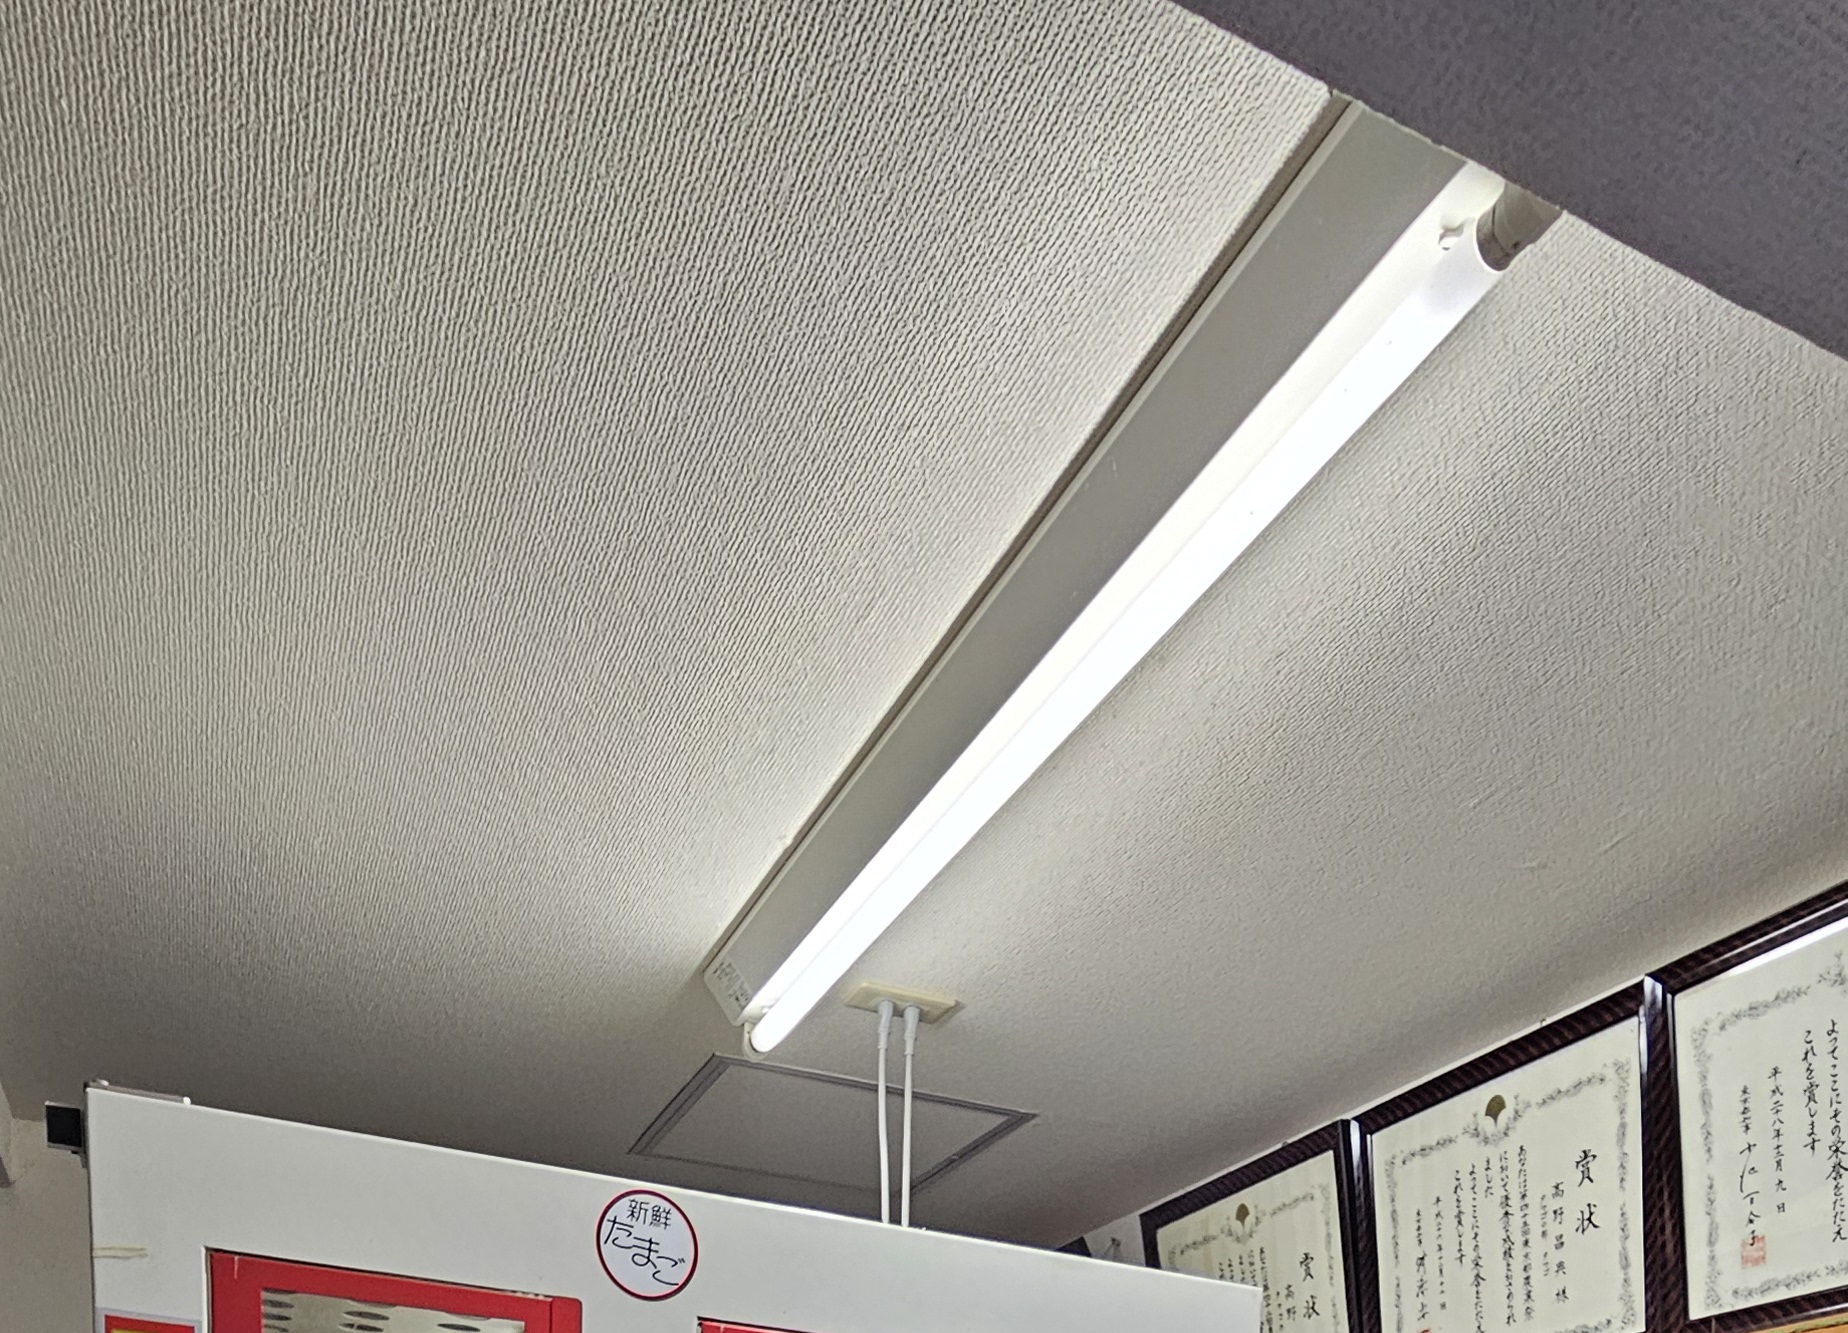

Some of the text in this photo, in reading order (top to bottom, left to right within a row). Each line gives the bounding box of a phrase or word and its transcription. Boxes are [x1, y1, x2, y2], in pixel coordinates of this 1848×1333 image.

[1802, 1029, 1820, 1157] これを賞します
[626, 1198, 673, 1231] 新鮮
[1575, 1148, 1600, 1235] 賞状
[603, 1215, 687, 1287] たまご
